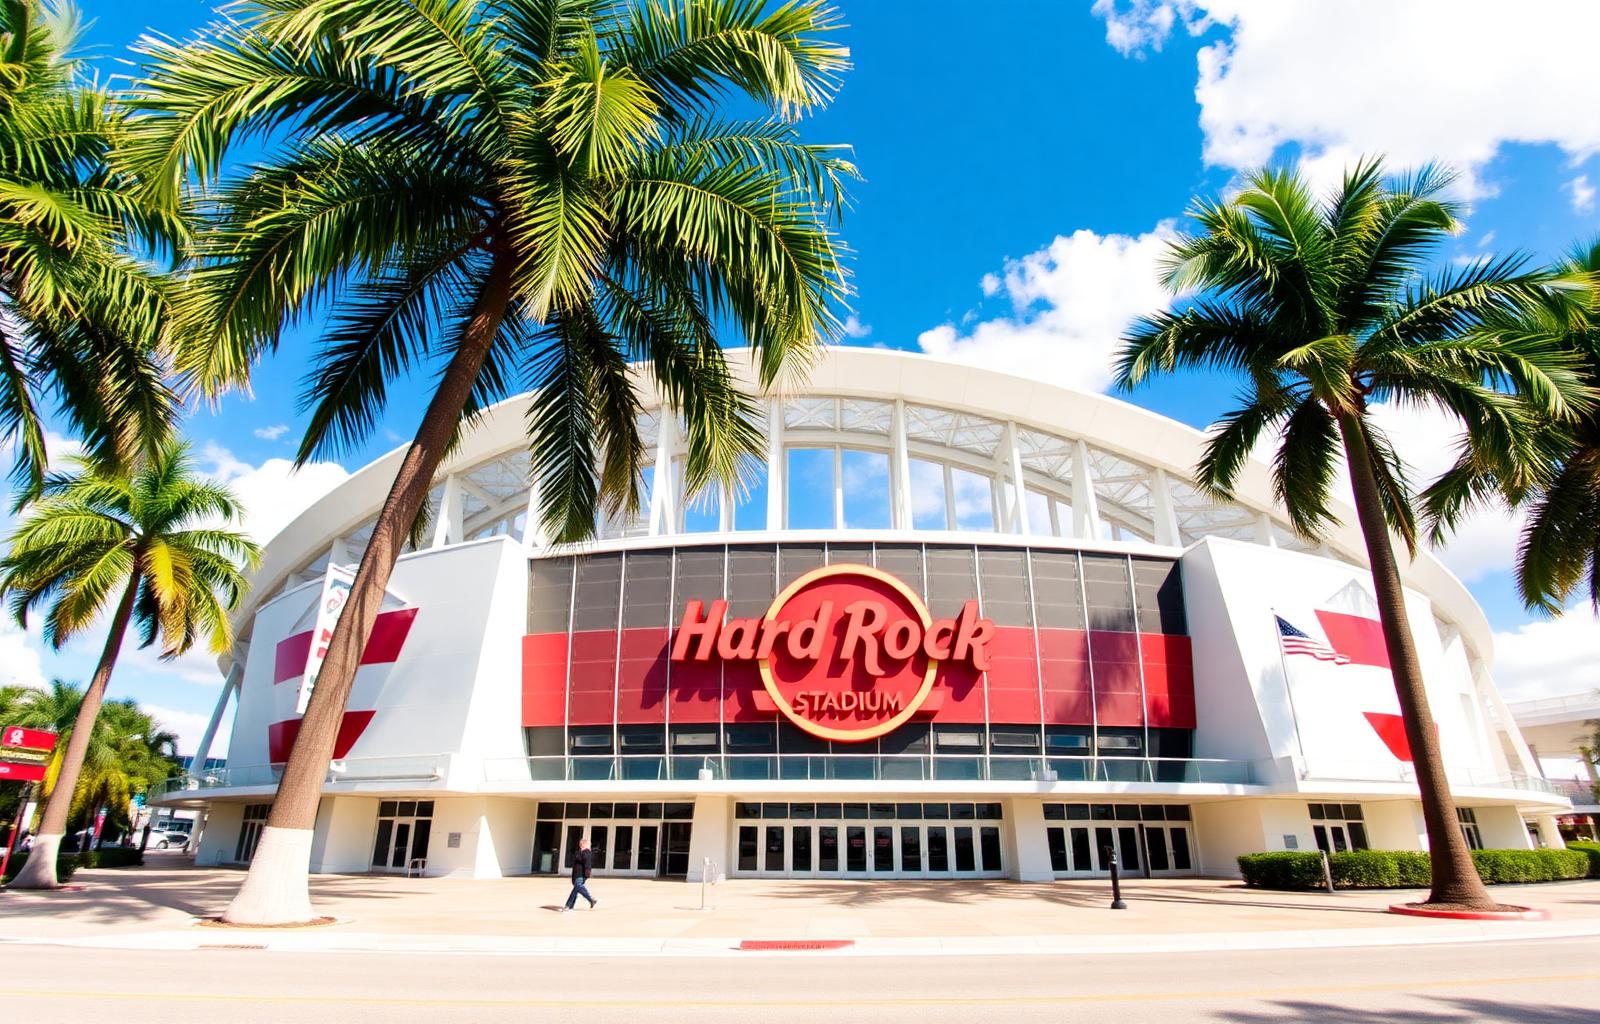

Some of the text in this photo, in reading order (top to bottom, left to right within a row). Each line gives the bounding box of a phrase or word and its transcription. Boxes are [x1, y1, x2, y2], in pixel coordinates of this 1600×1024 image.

[671, 599, 995, 676] Hard Rock
[792, 691, 903, 712] STADIUM
